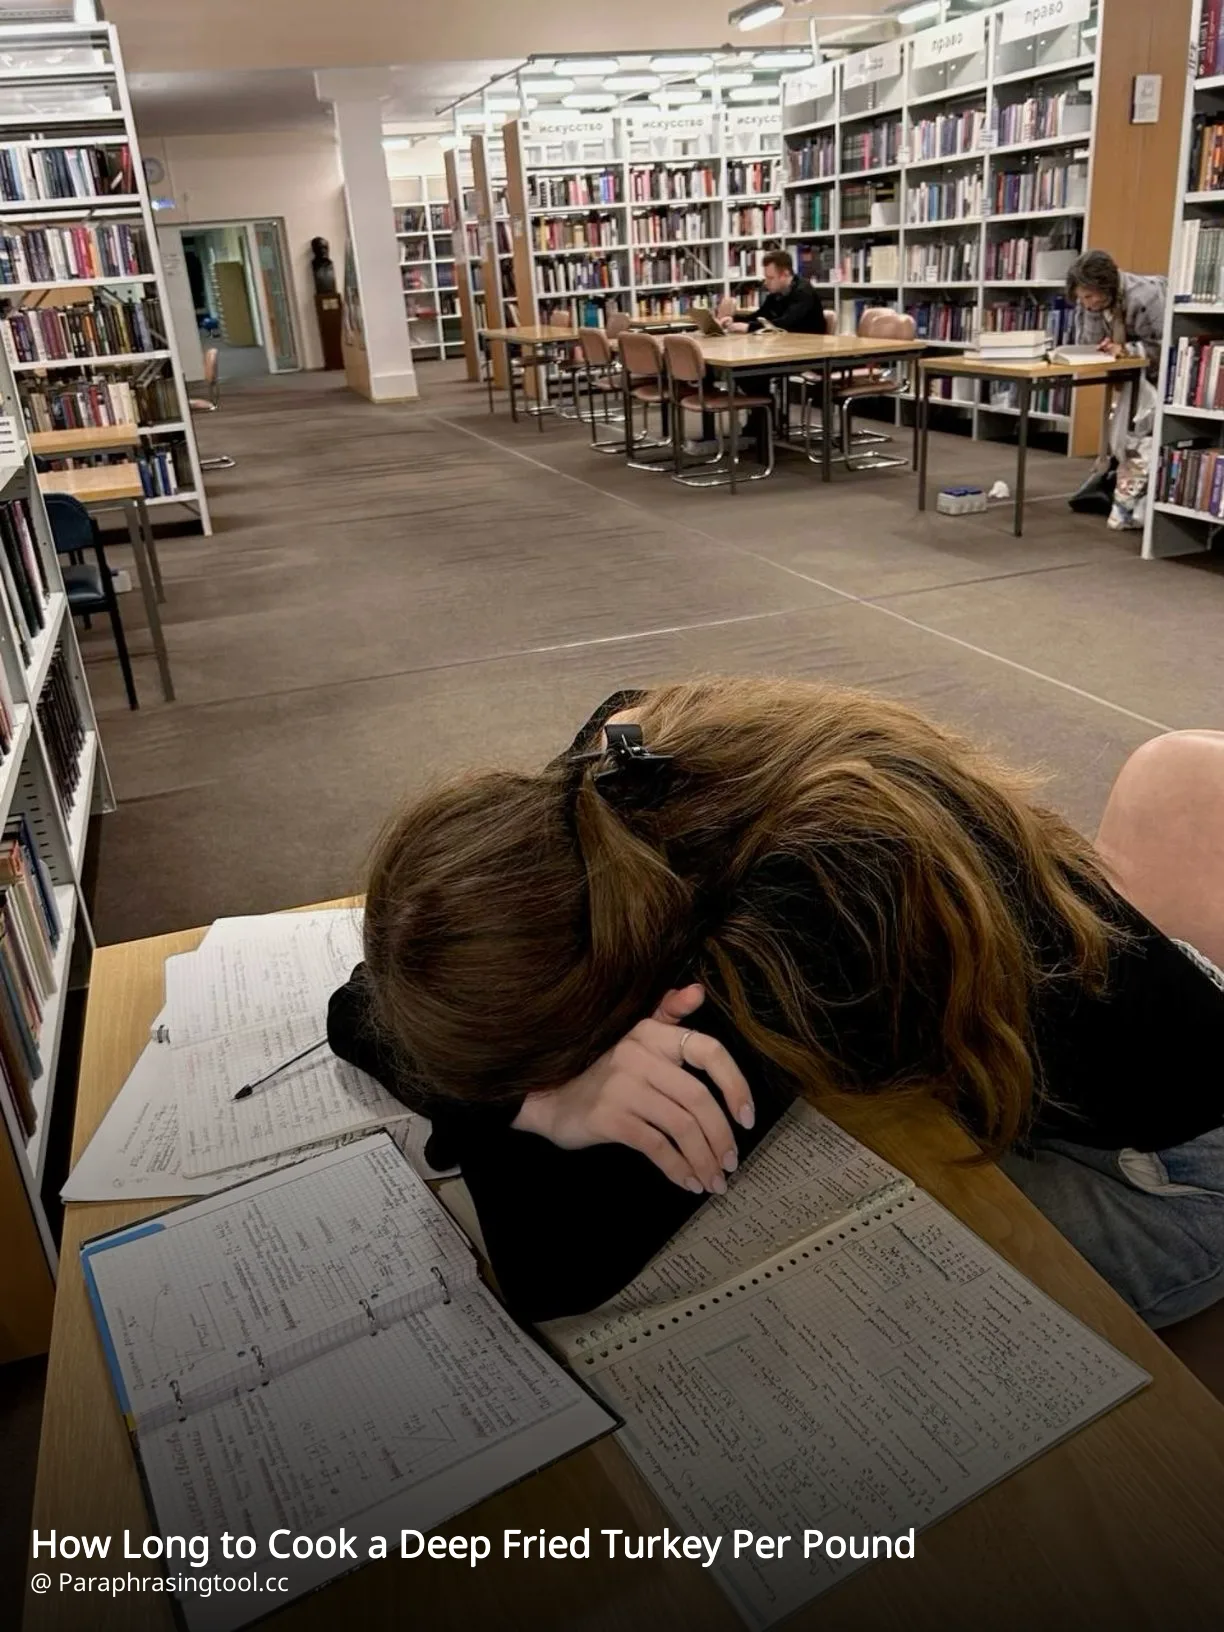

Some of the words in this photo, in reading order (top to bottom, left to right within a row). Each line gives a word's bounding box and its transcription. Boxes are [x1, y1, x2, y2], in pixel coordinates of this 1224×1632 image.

[1025, 1, 1063, 26] право
[538, 122, 604, 135] искусство
[641, 118, 704, 132] искусство
[737, 114, 782, 129] искусст
